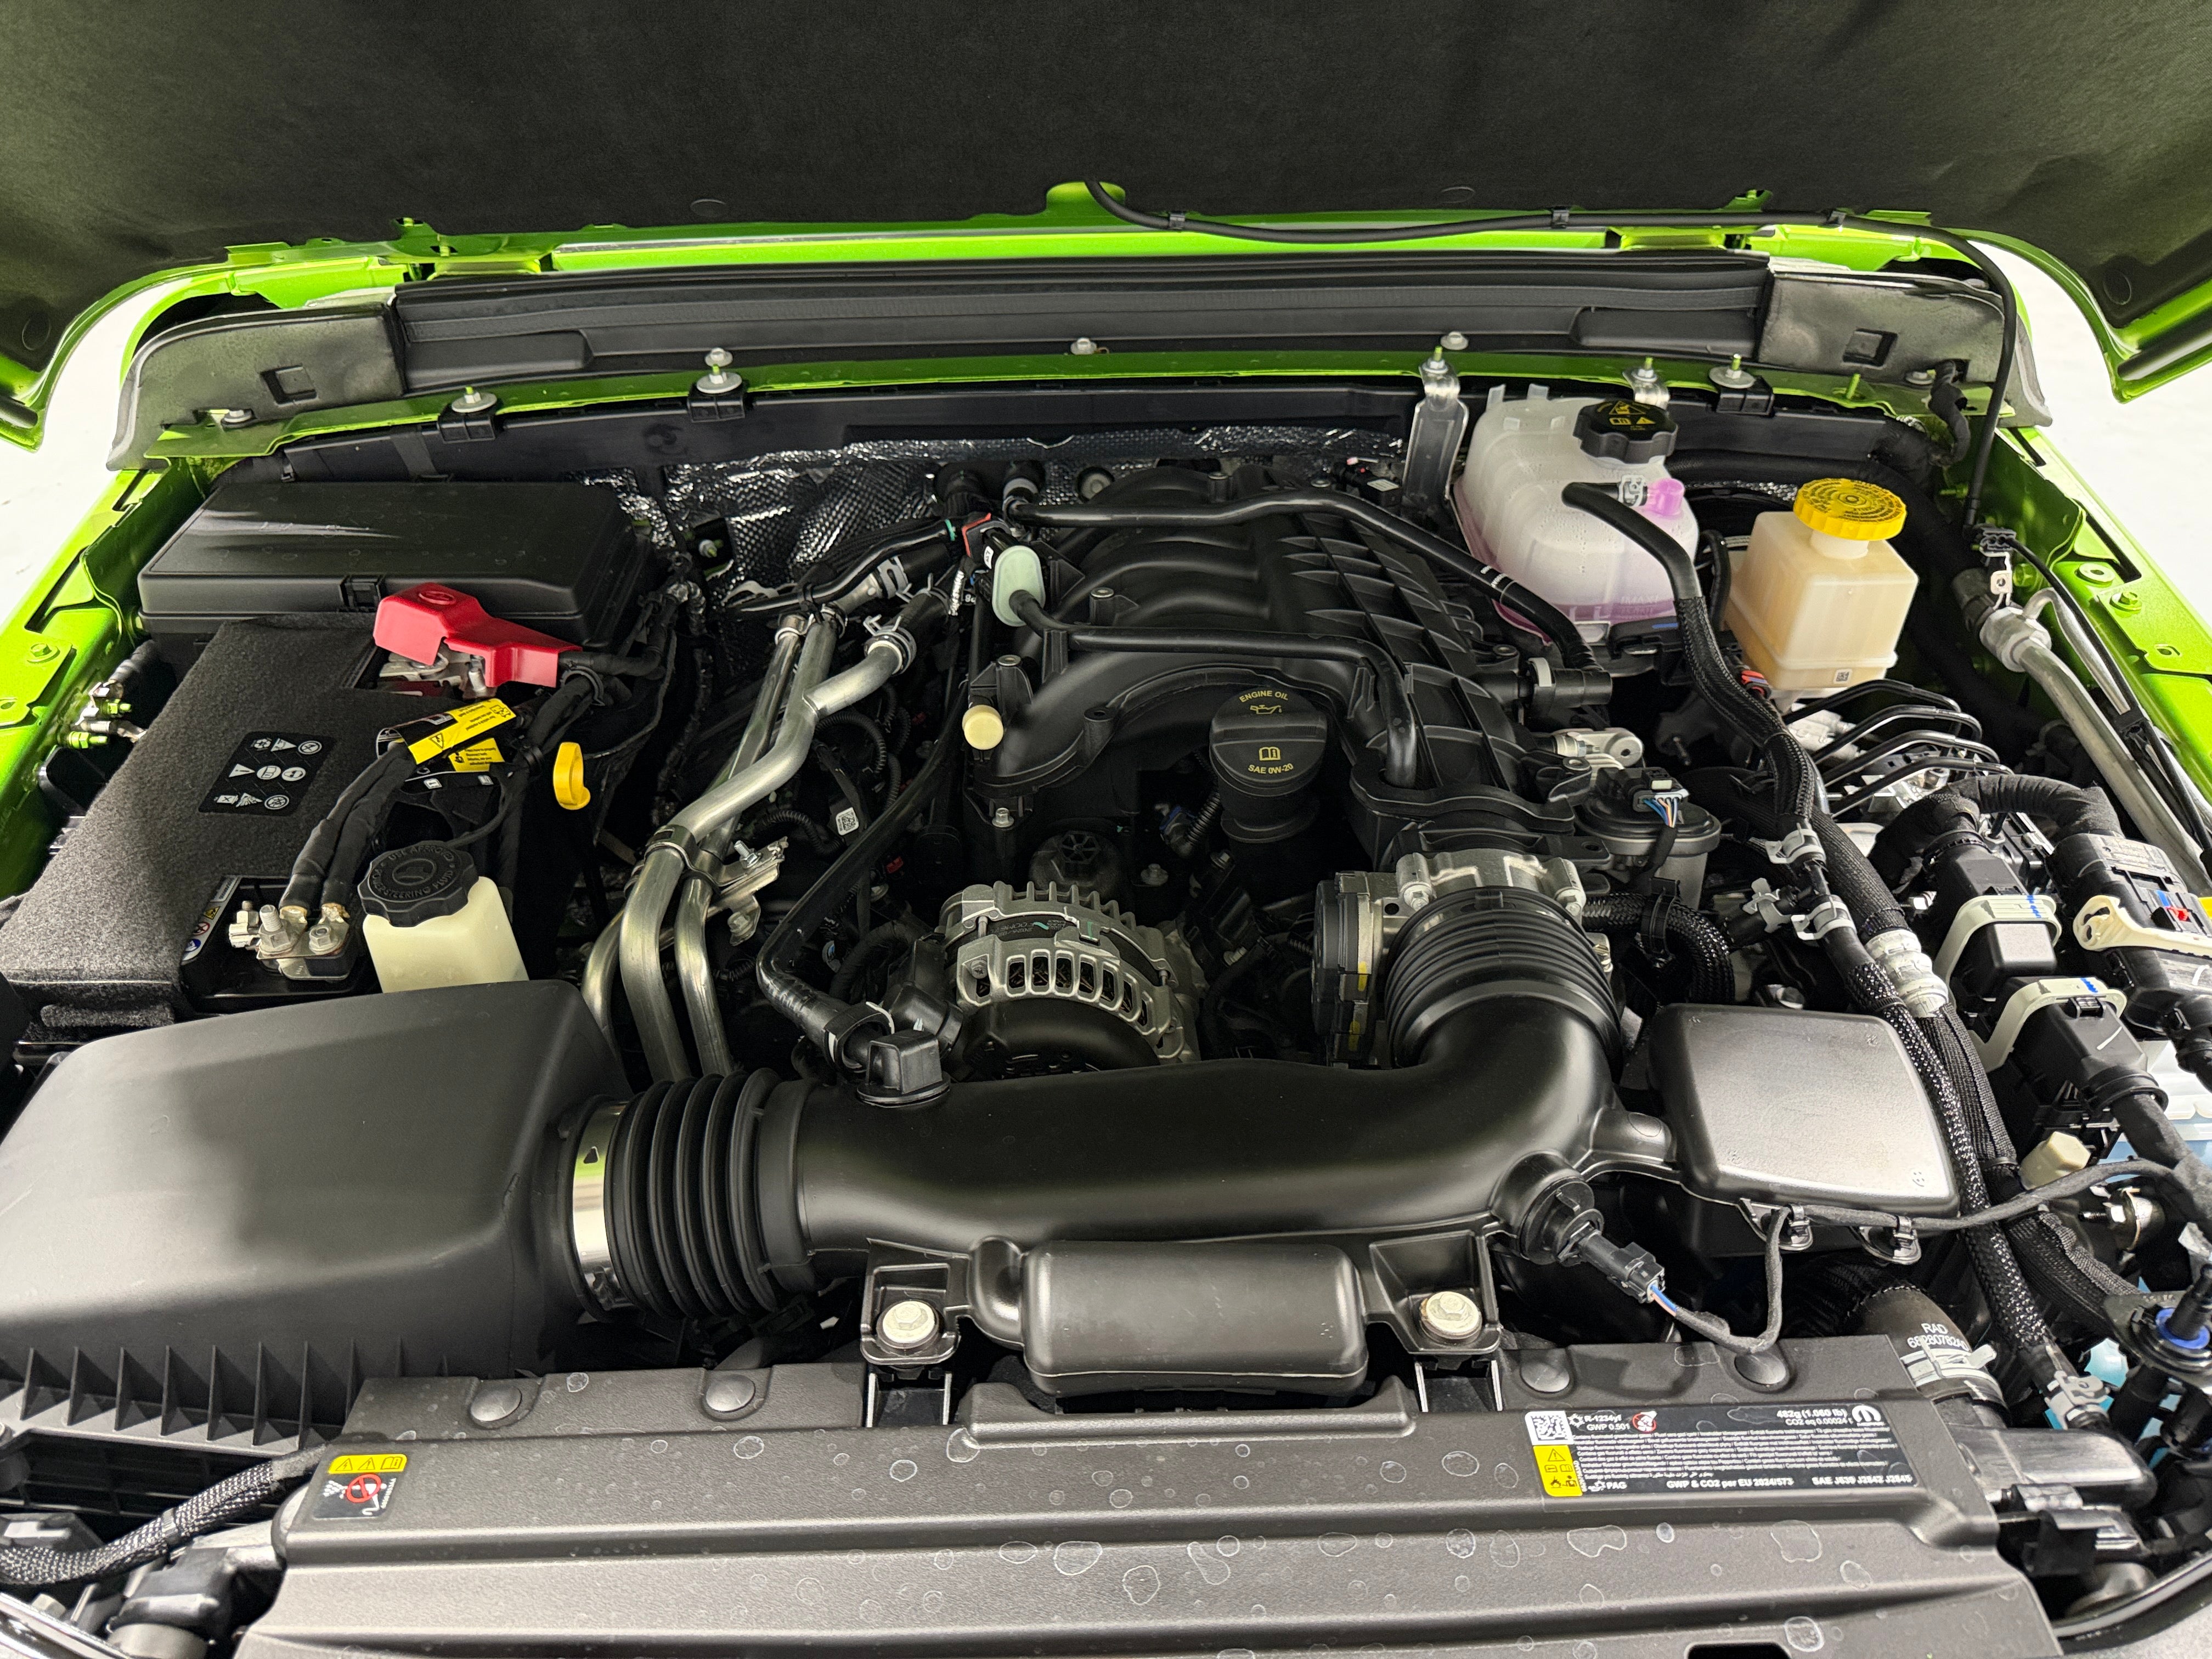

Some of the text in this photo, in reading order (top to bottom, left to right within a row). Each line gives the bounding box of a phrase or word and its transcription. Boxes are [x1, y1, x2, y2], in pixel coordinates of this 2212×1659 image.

[1239, 690, 1288, 703] ENGINE OIL
[1248, 763, 1294, 774] SAE 0W-20
[388, 845, 455, 862] USE APPROVED
[383, 885, 432, 899] STEERING
[432, 870, 454, 890] FLUID
[1921, 1323, 1948, 1334] RAD
[1606, 1481, 1628, 1489] PAG
[1666, 1480, 1689, 1488] GWP
[1691, 1480, 1699, 1488] &
[1700, 1480, 1721, 1488] CO2
[1738, 1479, 1753, 1487] EU
[1812, 1476, 1833, 1486] SAE
